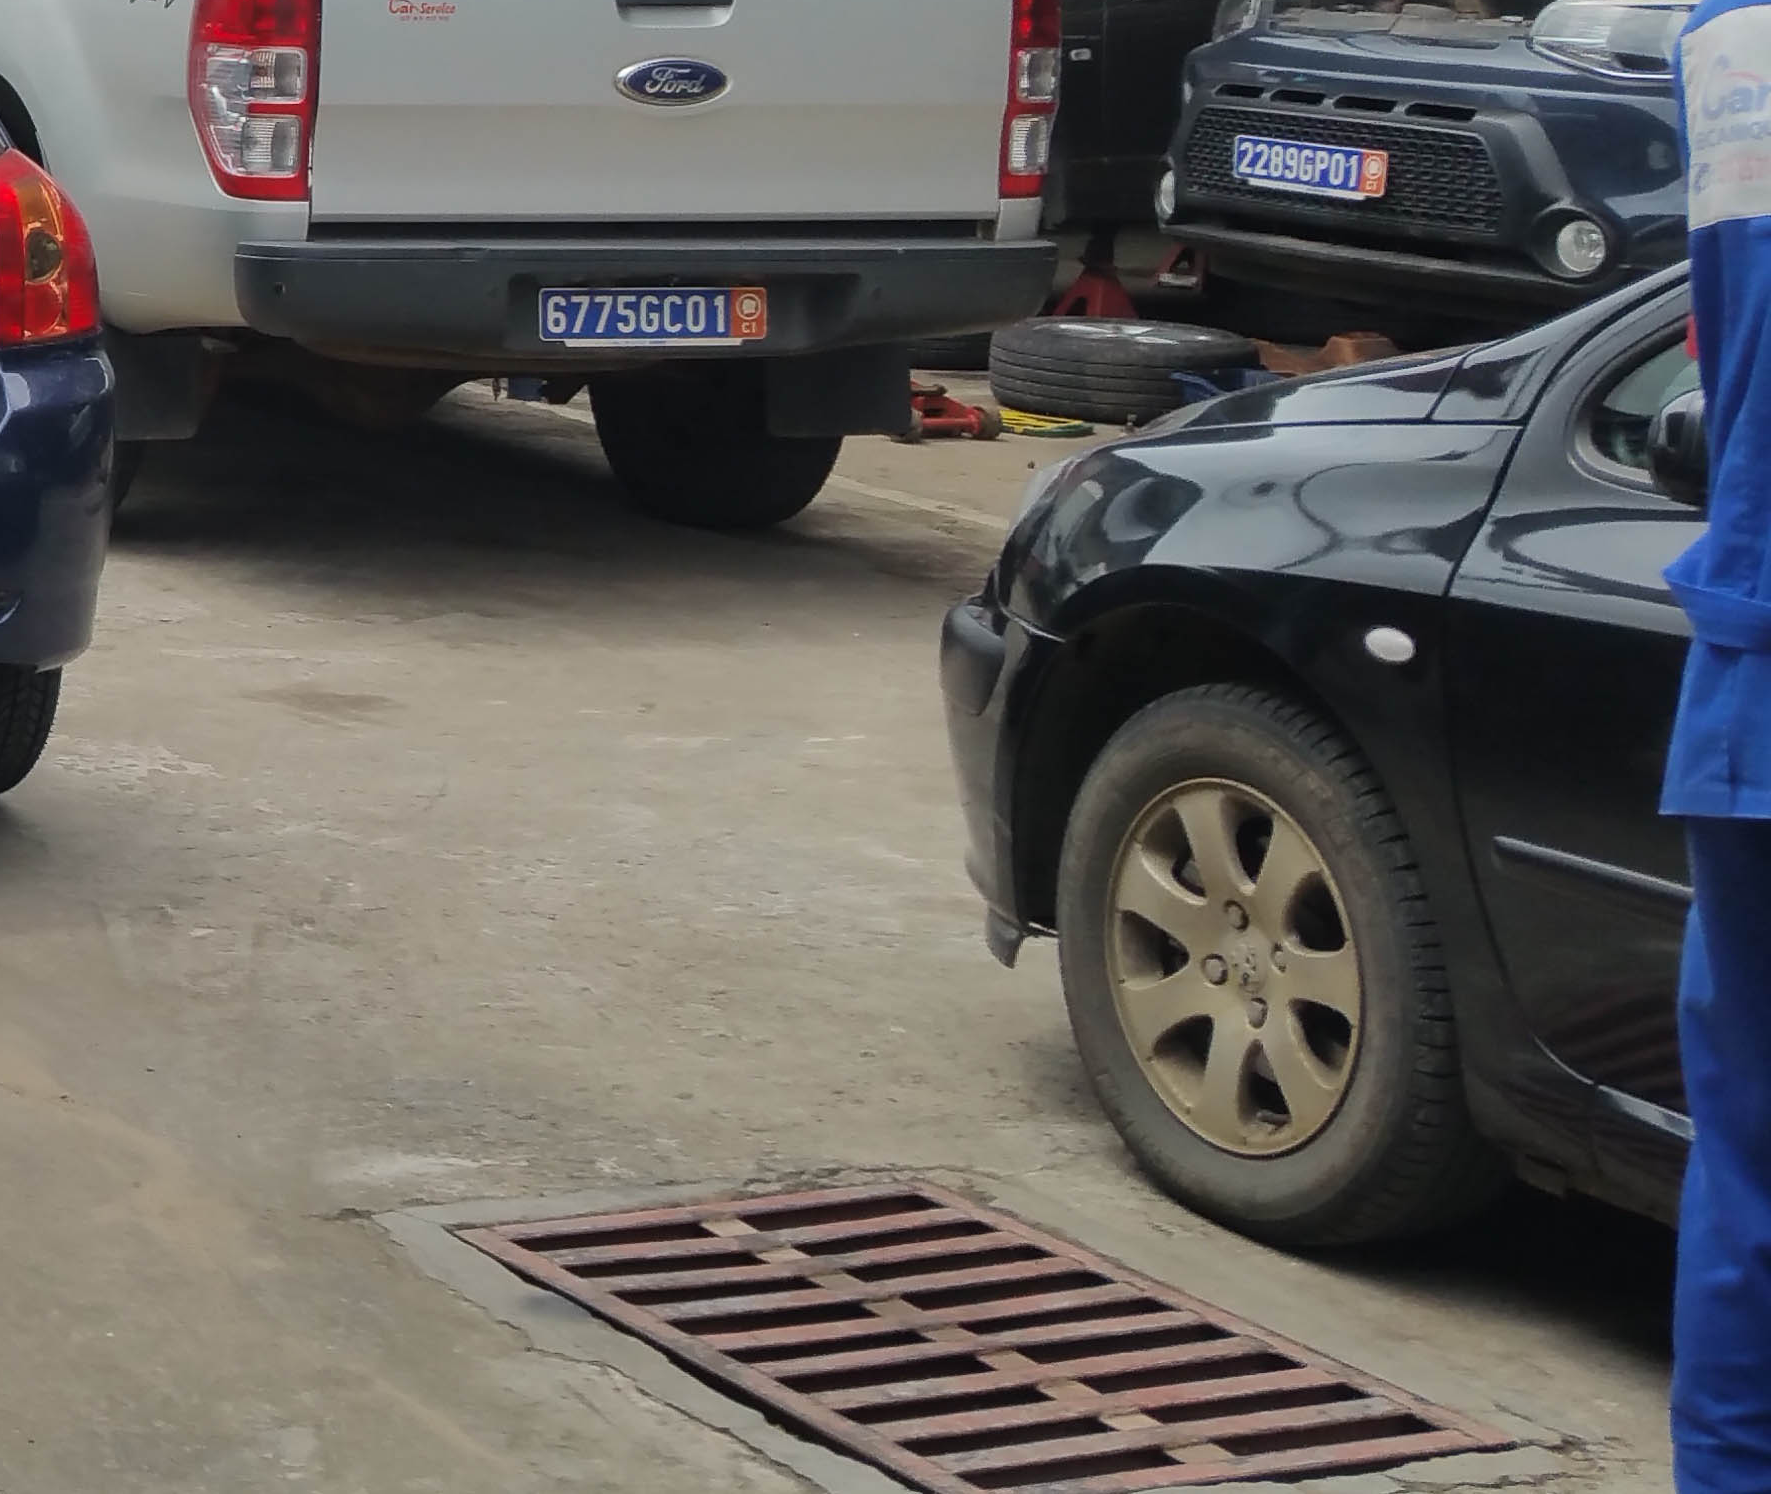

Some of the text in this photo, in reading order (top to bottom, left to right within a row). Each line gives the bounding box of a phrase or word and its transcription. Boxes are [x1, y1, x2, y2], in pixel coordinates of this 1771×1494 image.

[644, 66, 707, 94] Ford
[1237, 141, 1360, 189] 2289GP01
[546, 294, 726, 334] 6775GC01
